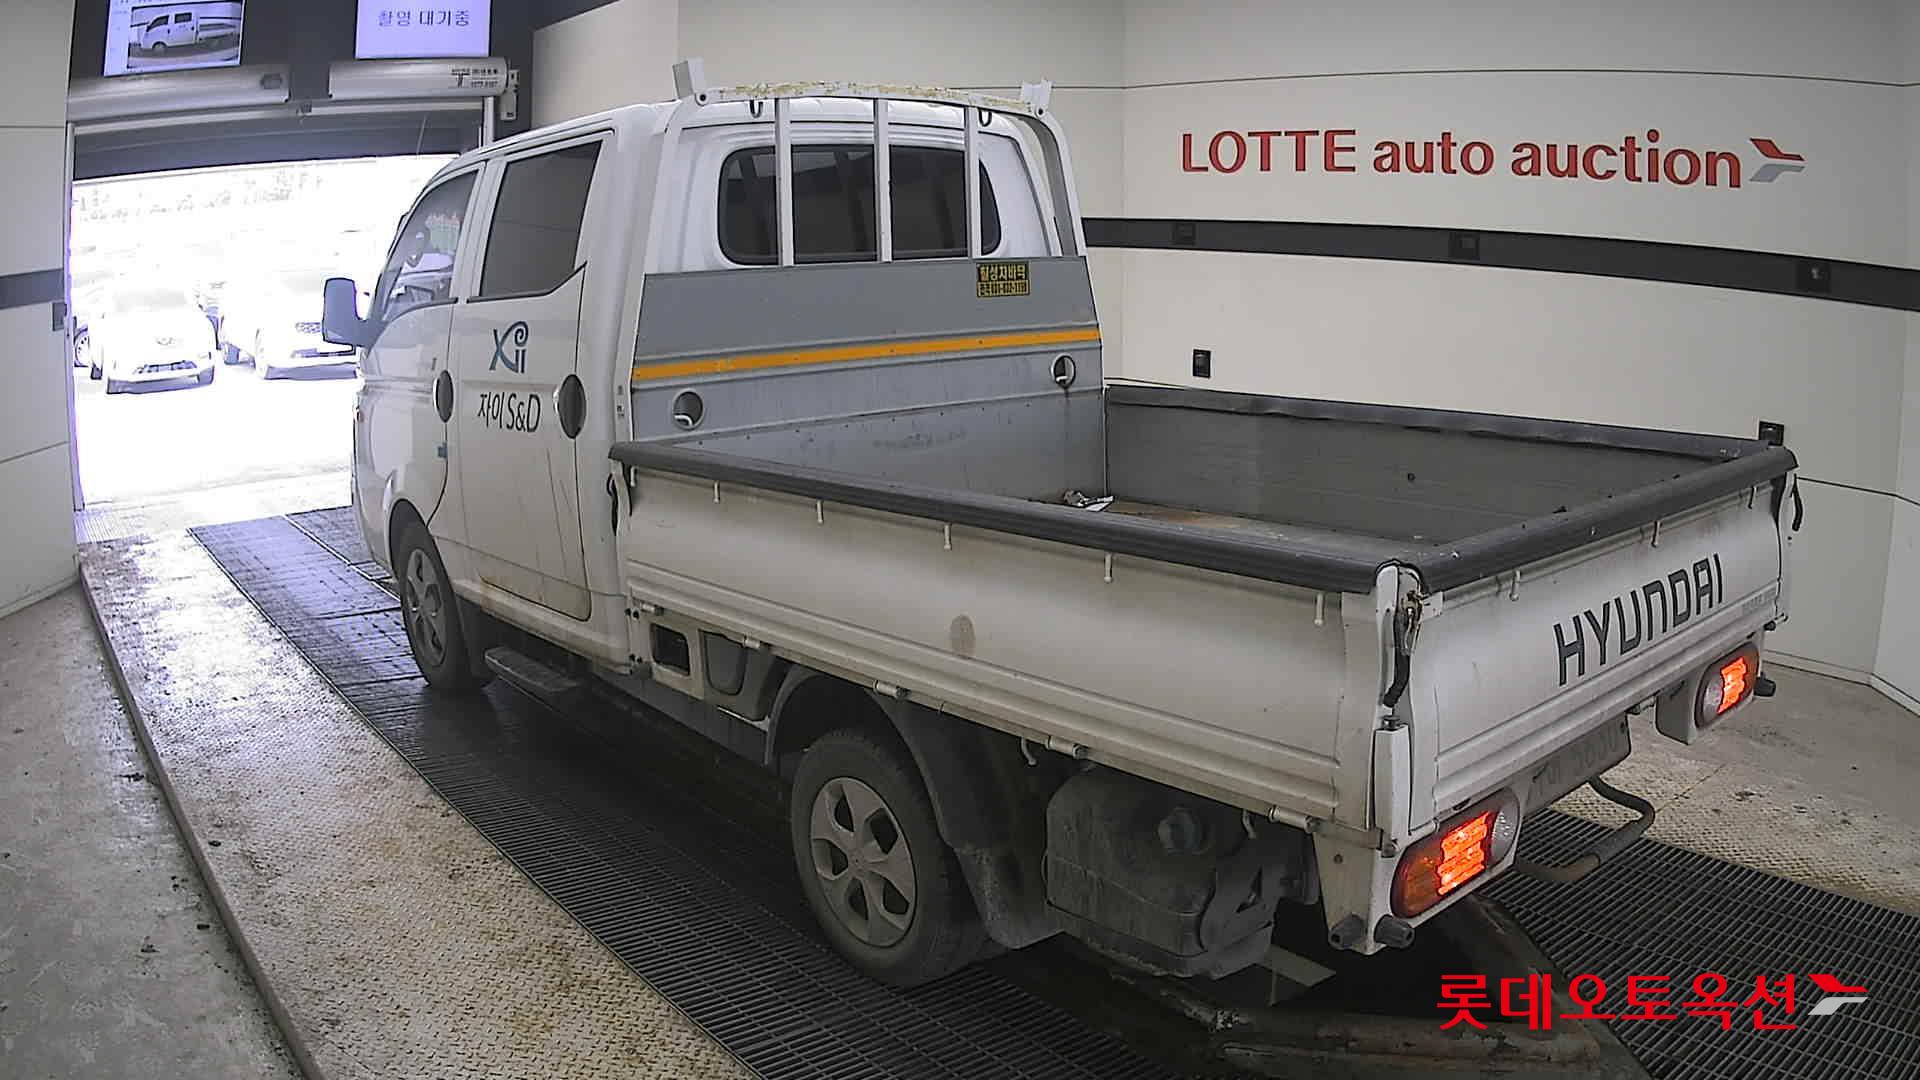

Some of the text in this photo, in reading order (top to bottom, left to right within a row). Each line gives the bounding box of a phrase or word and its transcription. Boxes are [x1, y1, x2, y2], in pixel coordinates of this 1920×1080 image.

[419, 10, 470, 27] 대기중
[1181, 129, 1743, 188] LOTTE auto auction
[477, 391, 541, 433] 자이 S&D
[1552, 553, 1723, 686] HYUNDAI
